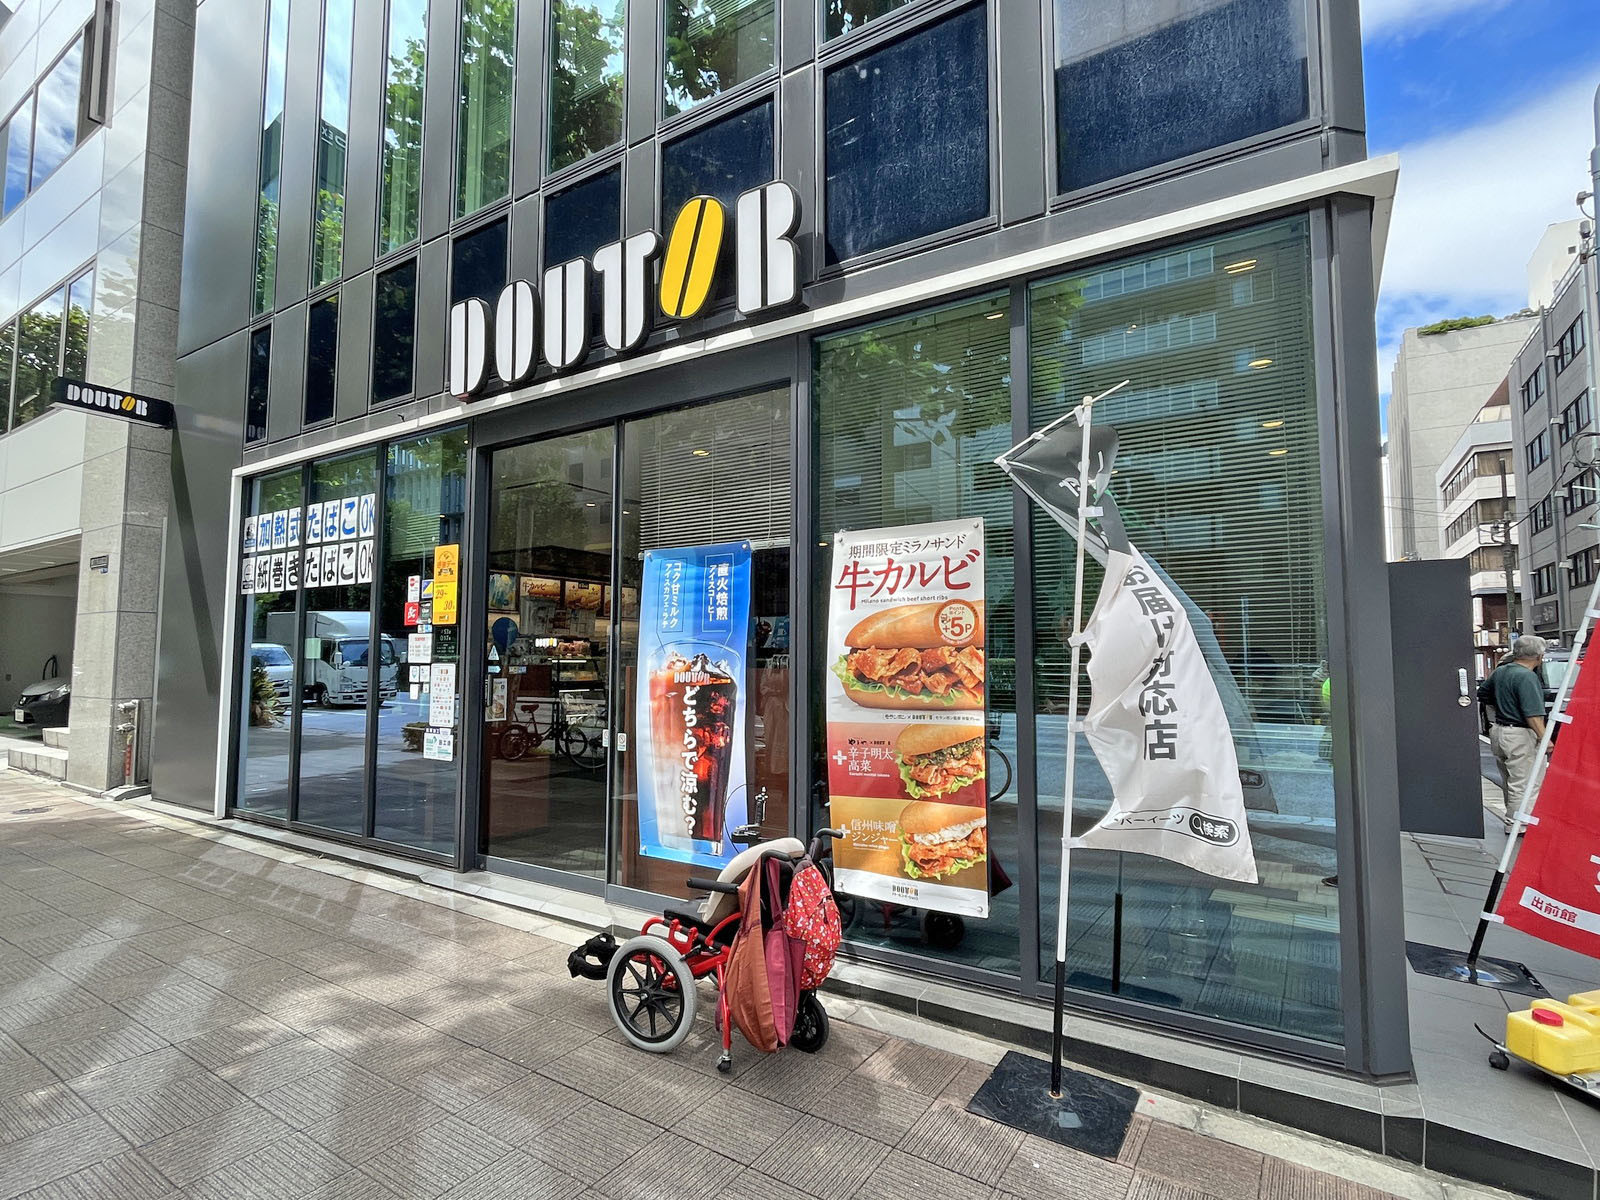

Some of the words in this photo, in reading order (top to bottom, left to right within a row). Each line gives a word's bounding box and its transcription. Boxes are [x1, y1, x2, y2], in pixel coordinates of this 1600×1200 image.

[450, 180, 797, 397] DOUTOR
[67, 384, 148, 416] DOUTOR
[848, 534, 967, 559] 期間限定ミラノサンド
[707, 564, 717, 622] アイスコーヒー
[835, 549, 981, 611] 牛カルビ
[669, 561, 683, 629] コク甘ミルク
[674, 670, 710, 685] DOUTOR
[848, 746, 893, 761] 辛子明太
[848, 759, 872, 772] 高菜
[851, 818, 897, 834] 信州味噌
[851, 831, 899, 846] ジンジャー
[1114, 814, 1185, 825] バーイーツ
[1203, 821, 1230, 840] 検索
[1531, 895, 1578, 924] 出前館
